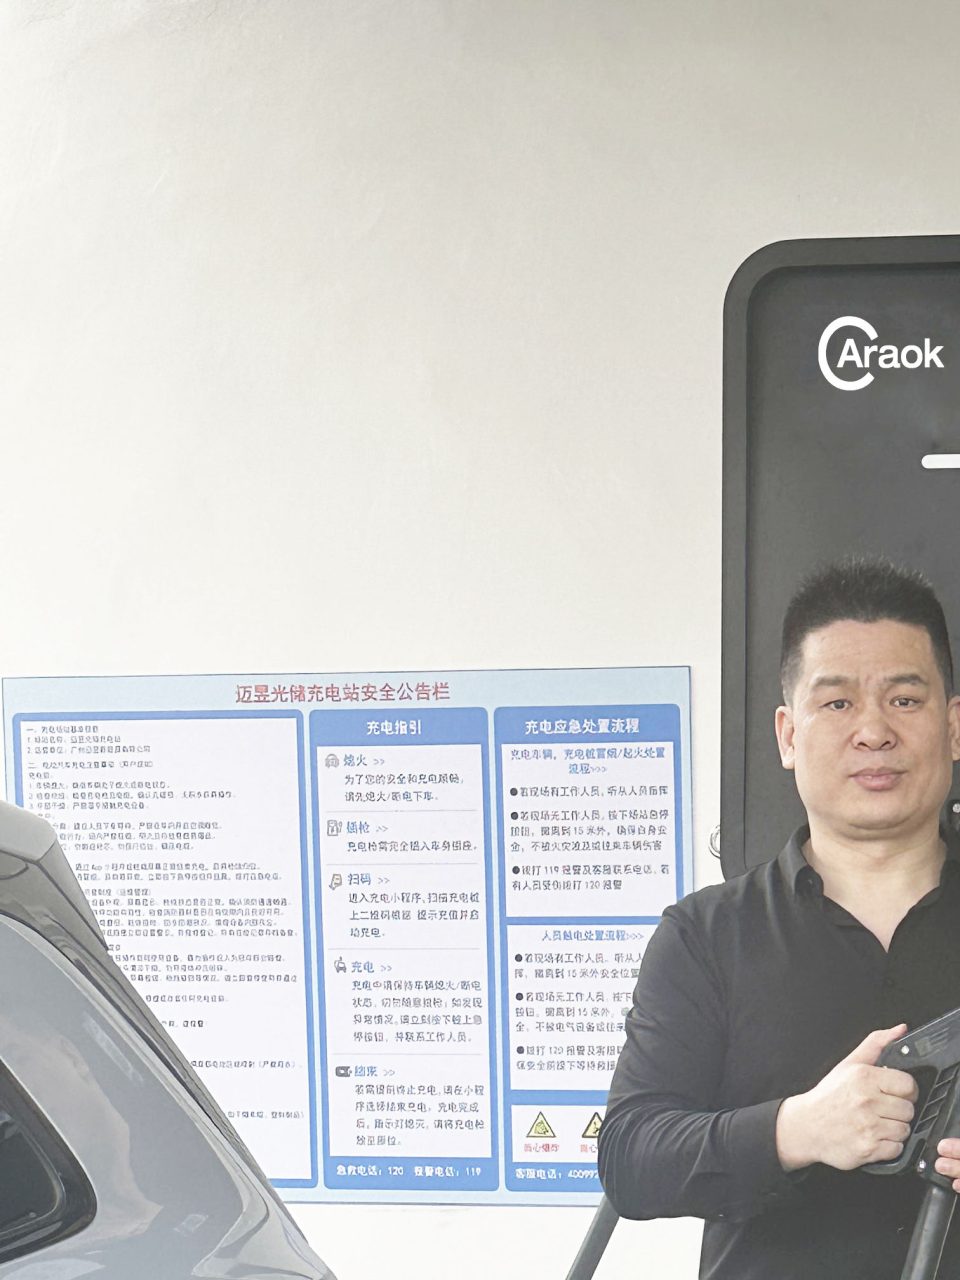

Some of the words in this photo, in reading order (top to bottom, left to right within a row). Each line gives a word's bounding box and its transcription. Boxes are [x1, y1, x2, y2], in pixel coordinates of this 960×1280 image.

[235, 680, 451, 704] 迈昱光储充电站安全公告栏
[366, 719, 422, 736] 充电指引
[524, 718, 640, 735] 充电应急处置流程
[347, 873, 371, 886] 扫码
[351, 961, 375, 974] 充电
